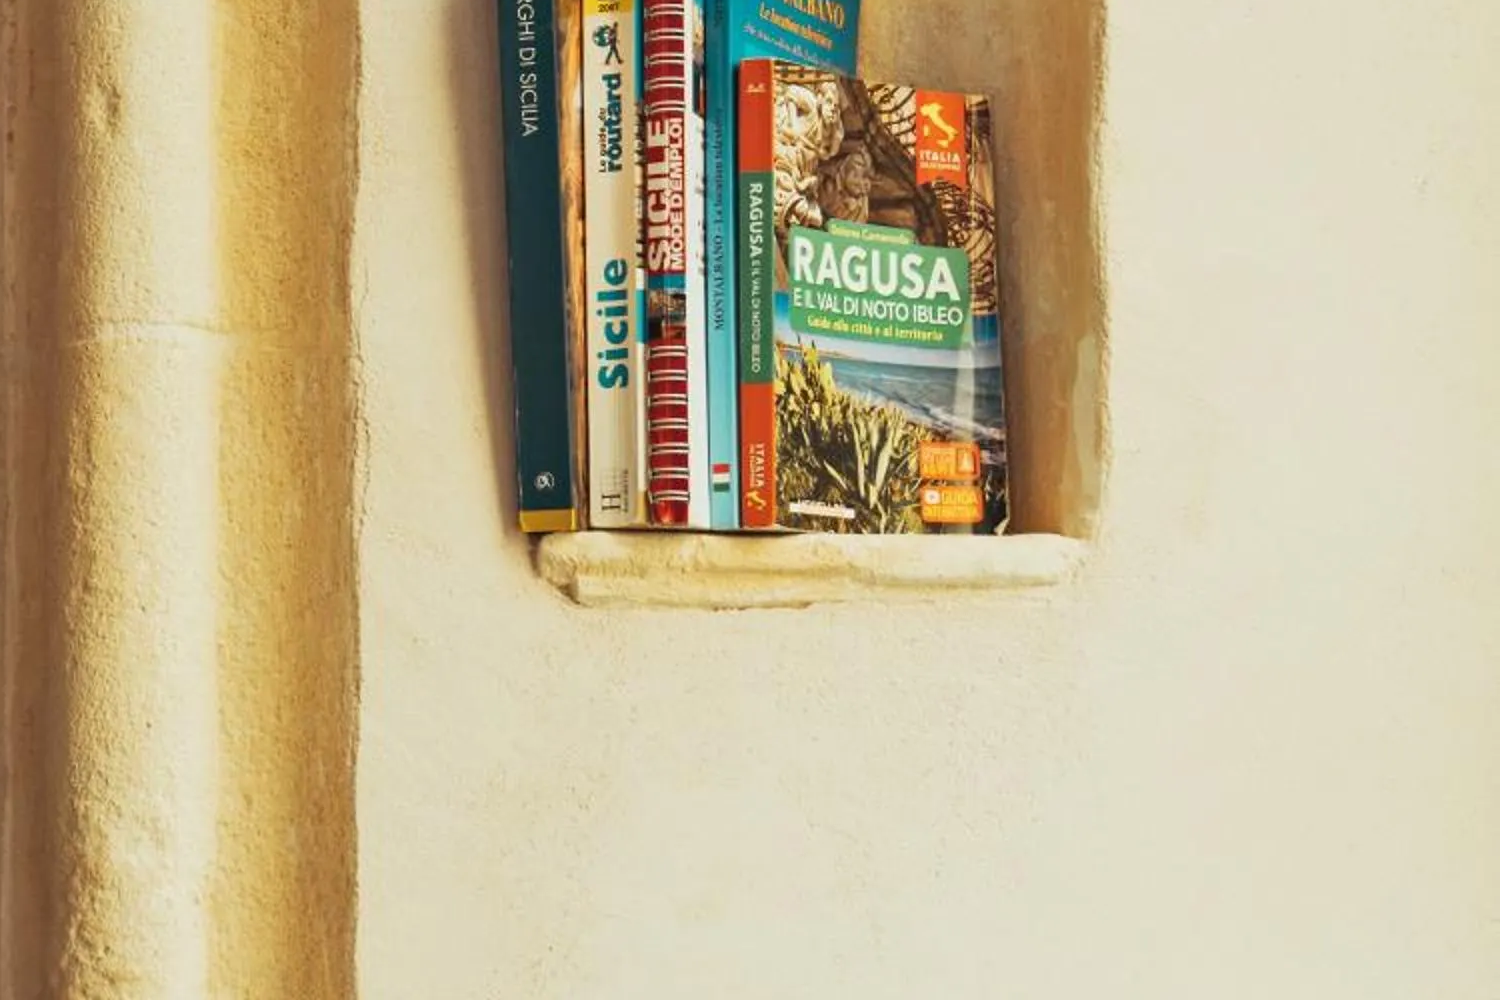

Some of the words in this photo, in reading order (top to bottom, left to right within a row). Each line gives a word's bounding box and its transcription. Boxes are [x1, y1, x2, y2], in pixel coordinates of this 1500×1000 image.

[519, 47, 536, 66] DI
[519, 73, 540, 137] SICILIA
[601, 73, 623, 172] routard
[598, 127, 607, 157] guide
[920, 150, 960, 162] ITALIA
[598, 159, 606, 173] Le
[647, 118, 670, 272] SICILE
[670, 211, 684, 270] MODE
[749, 182, 763, 257] RAGUSA
[714, 235, 725, 330] MONTALBANO
[751, 278, 761, 296] VAL
[793, 236, 961, 301] RAGUSA
[596, 258, 628, 389] Sicile
[751, 311, 761, 341] NOTO
[793, 287, 802, 307] E
[805, 288, 815, 309] IL
[816, 291, 841, 314] VAL
[843, 296, 859, 317] DI
[862, 299, 909, 322] NOTO
[912, 303, 963, 326] IBLEO
[807, 315, 830, 329] Guida
[755, 443, 765, 488] ITALIA
